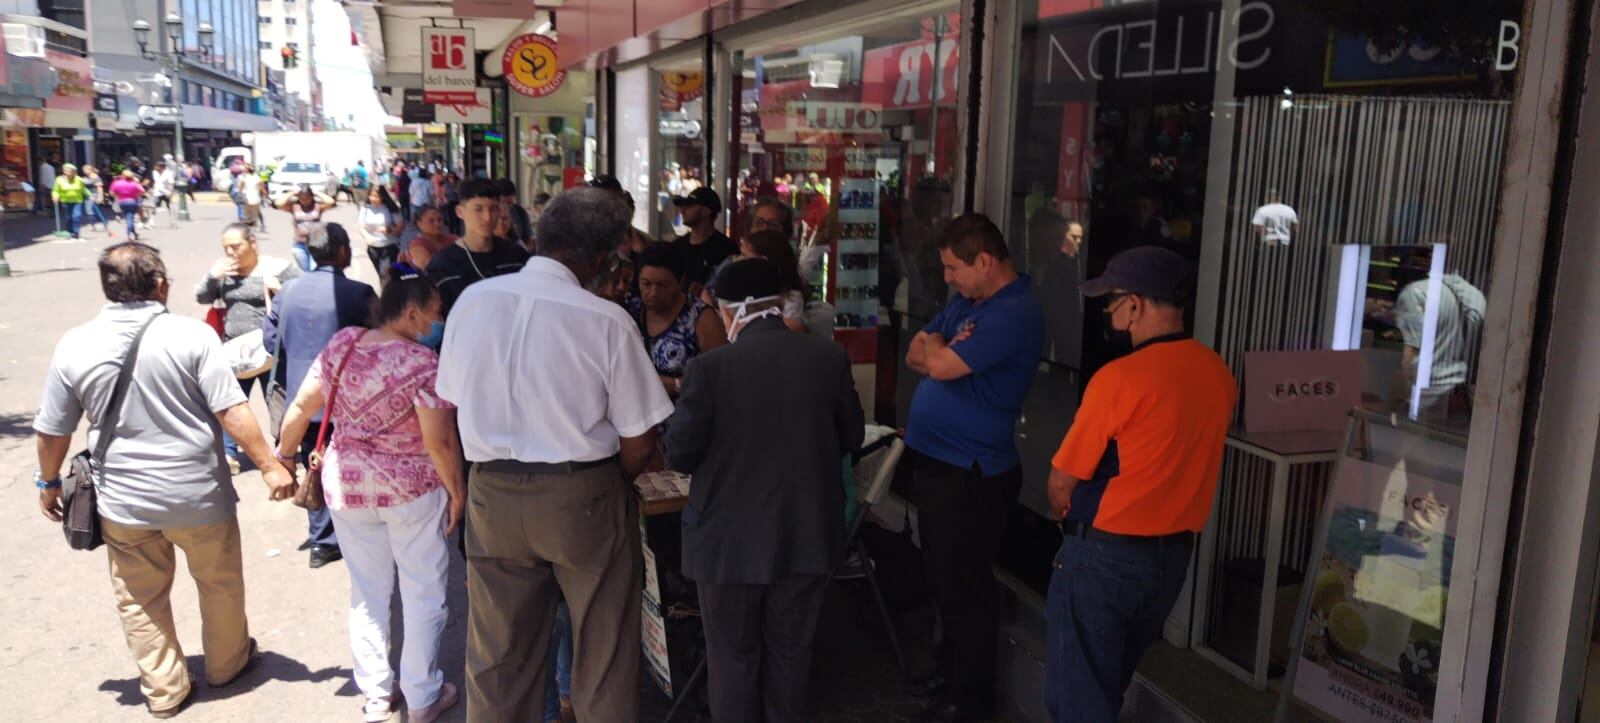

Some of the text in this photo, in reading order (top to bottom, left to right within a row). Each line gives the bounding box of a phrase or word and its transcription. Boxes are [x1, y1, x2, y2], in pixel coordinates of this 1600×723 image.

[504, 37, 523, 62] SALUD
[1496, 20, 1520, 70] B
[424, 75, 476, 86] del barco
[505, 73, 535, 96] SUPER
[1275, 381, 1335, 397] FACES
